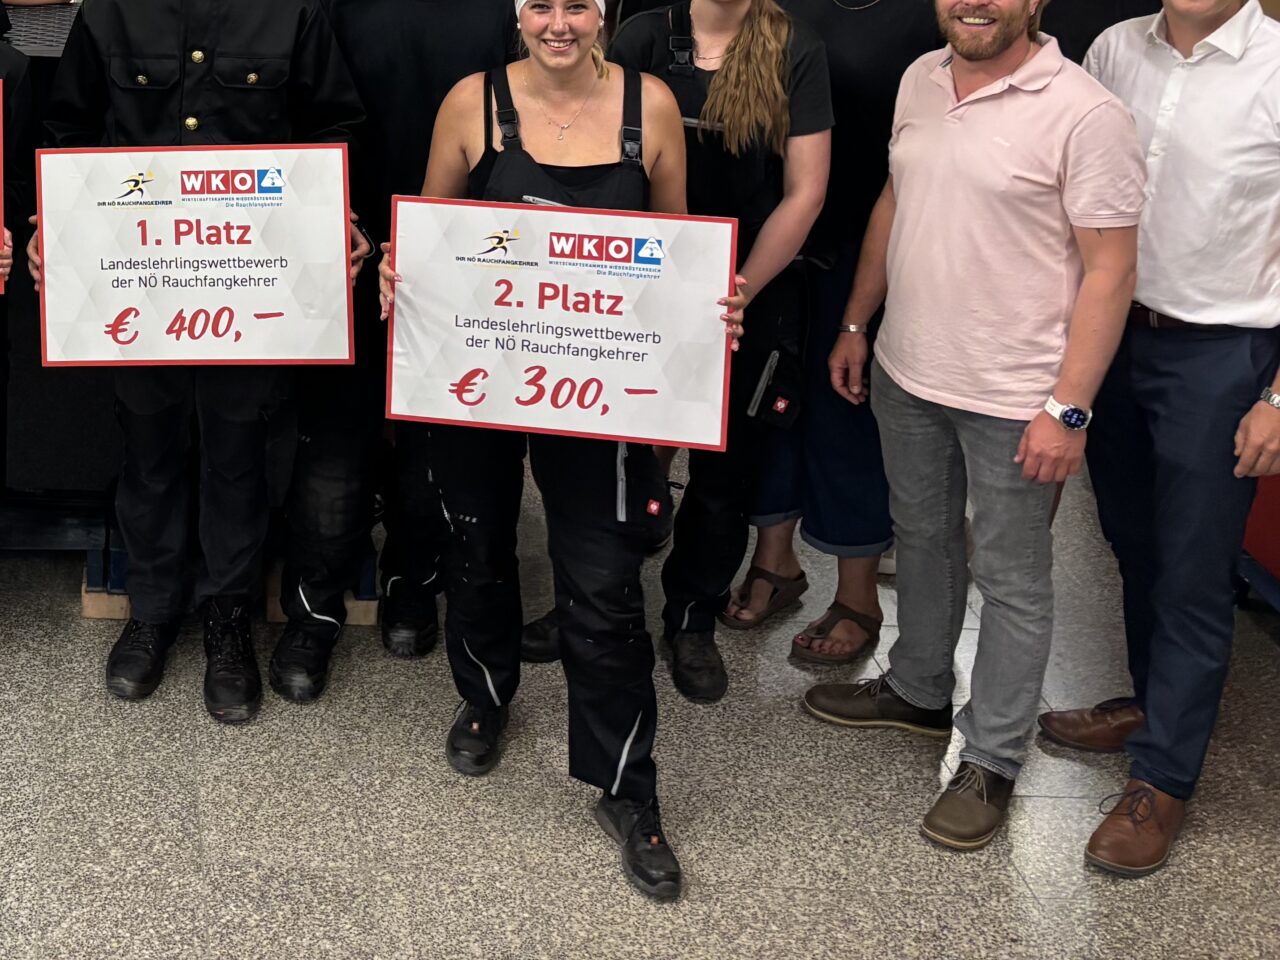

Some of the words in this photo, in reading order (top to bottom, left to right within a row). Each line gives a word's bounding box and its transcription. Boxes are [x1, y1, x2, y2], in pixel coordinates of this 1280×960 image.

[181, 172, 253, 192] WKO
[137, 219, 162, 246] 1.
[174, 218, 252, 245] Platz
[551, 235, 629, 259] WKO
[100, 256, 288, 272] Landeslehrlingswettbewerb
[111, 276, 134, 289] der
[138, 272, 158, 288] NÖ
[162, 275, 278, 290] Rauchfangkehrer
[494, 278, 524, 308] 2.
[537, 282, 624, 316] Platz
[104, 306, 140, 345] €
[455, 315, 662, 344] Landeslehrlingswettbewerb
[465, 336, 490, 350] der
[495, 334, 517, 352] NÖ
[521, 339, 649, 363] Rauchfangkehrer
[448, 367, 489, 407] €
